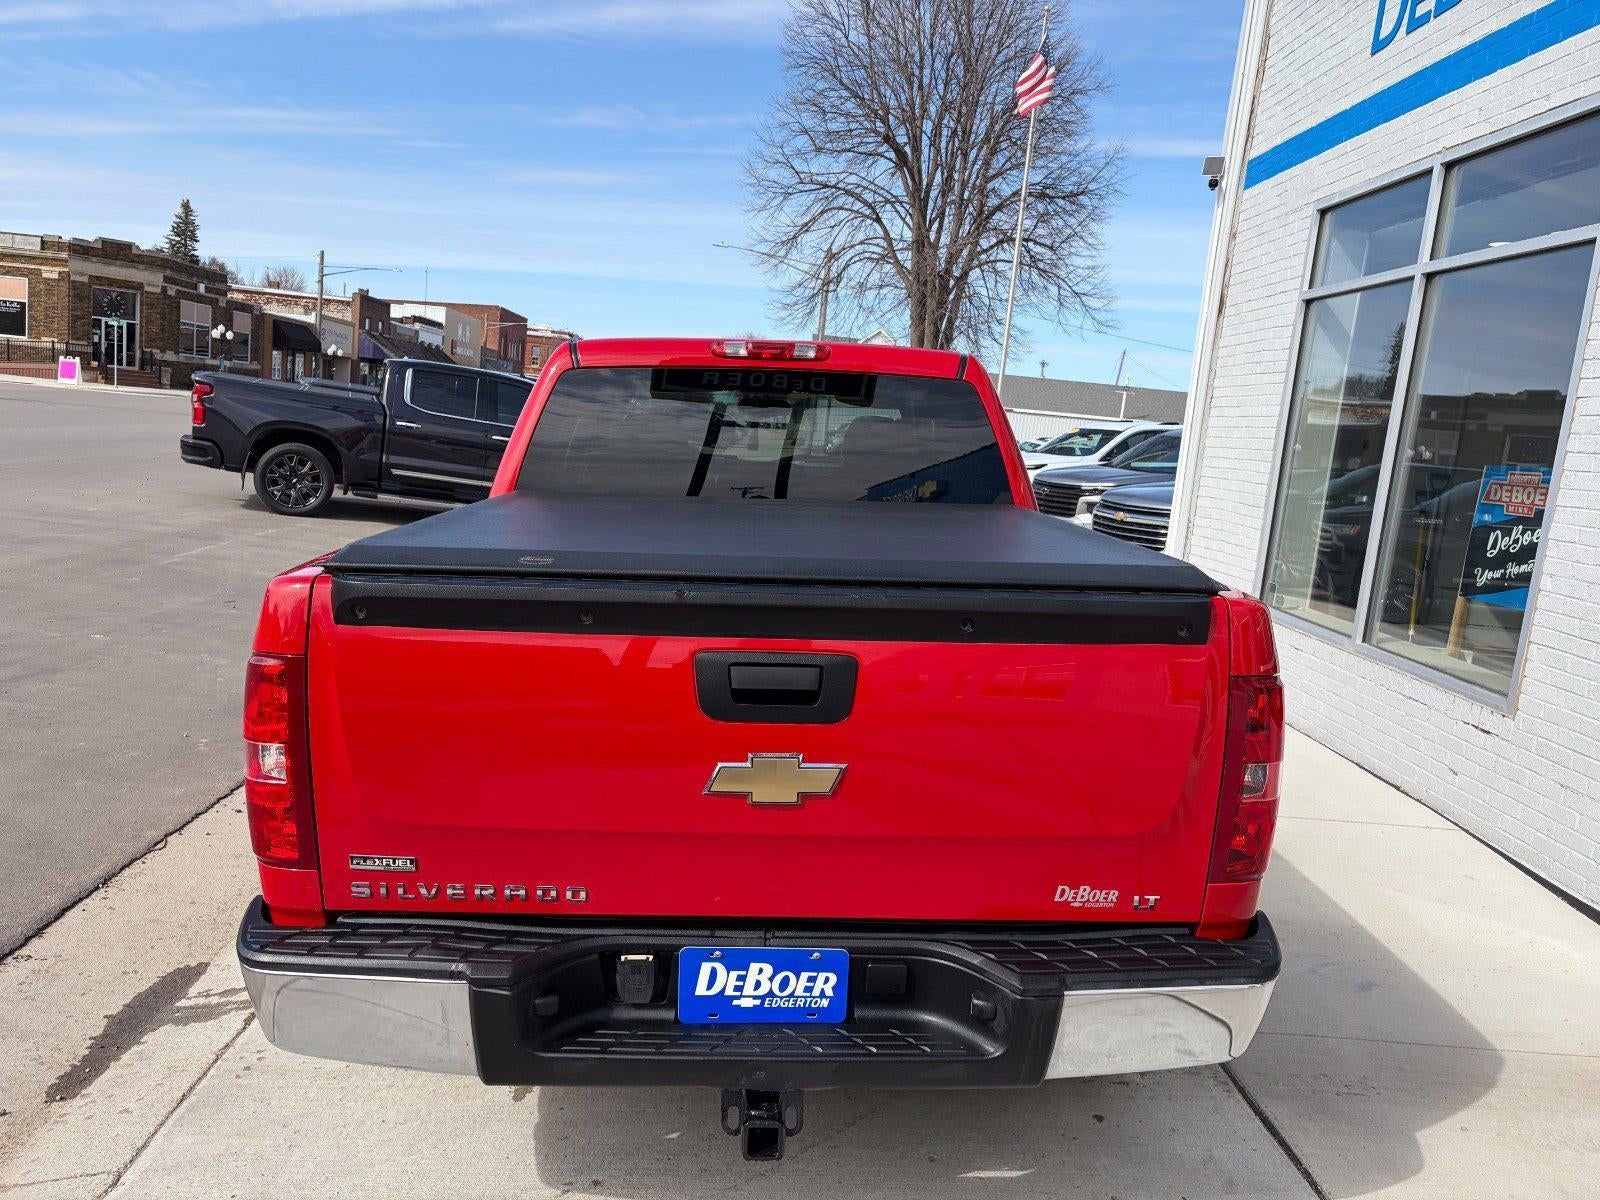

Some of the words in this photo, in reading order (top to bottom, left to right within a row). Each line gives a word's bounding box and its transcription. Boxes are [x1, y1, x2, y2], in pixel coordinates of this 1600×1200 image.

[1370, 0, 1460, 55] DE
[1474, 567, 1504, 587] Your
[1505, 560, 1535, 578] Home
[352, 857, 414, 868] FLEXFUEL
[350, 881, 588, 903] SILVERADO
[1133, 895, 1160, 910] LT
[763, 997, 830, 1008] EDGERTON
